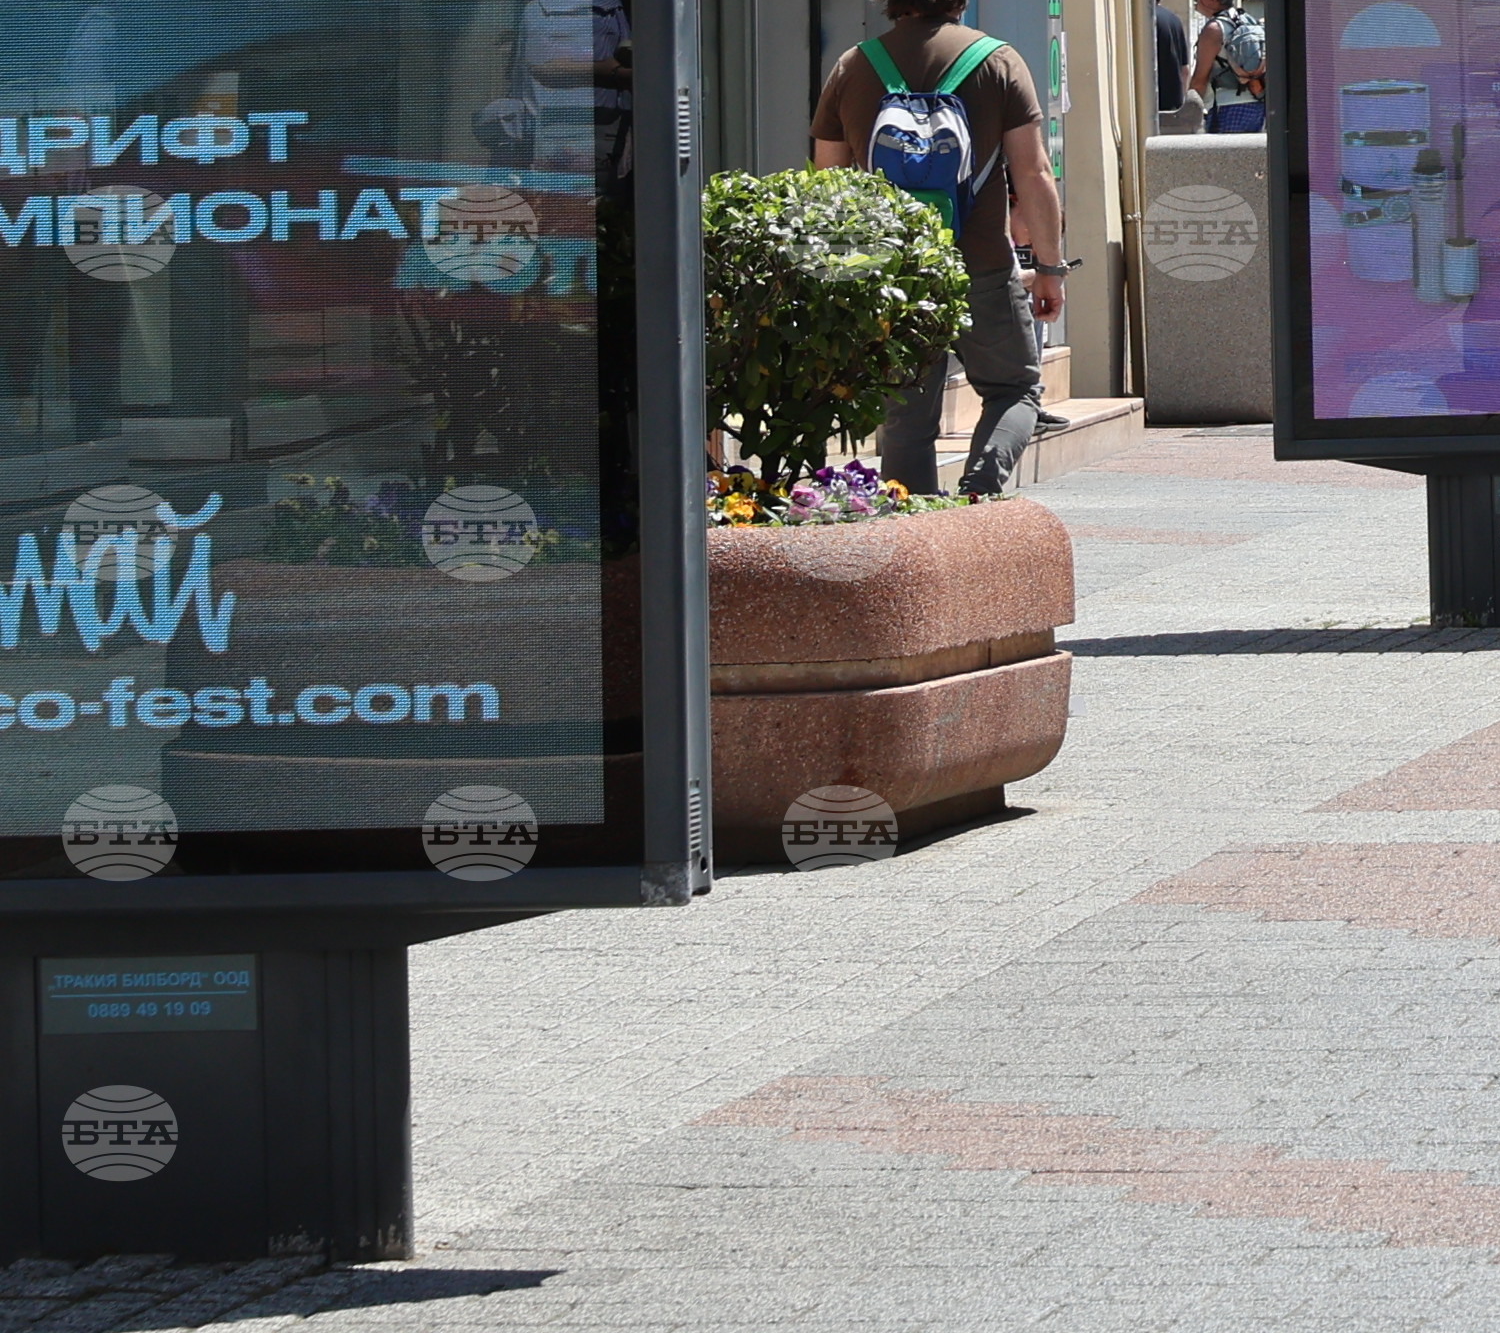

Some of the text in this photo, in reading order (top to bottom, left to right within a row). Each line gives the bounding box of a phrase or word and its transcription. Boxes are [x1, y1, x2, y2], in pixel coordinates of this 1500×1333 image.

[213, 970, 250, 987] ООД
[88, 1000, 212, 1018] 0889 49 19 09
